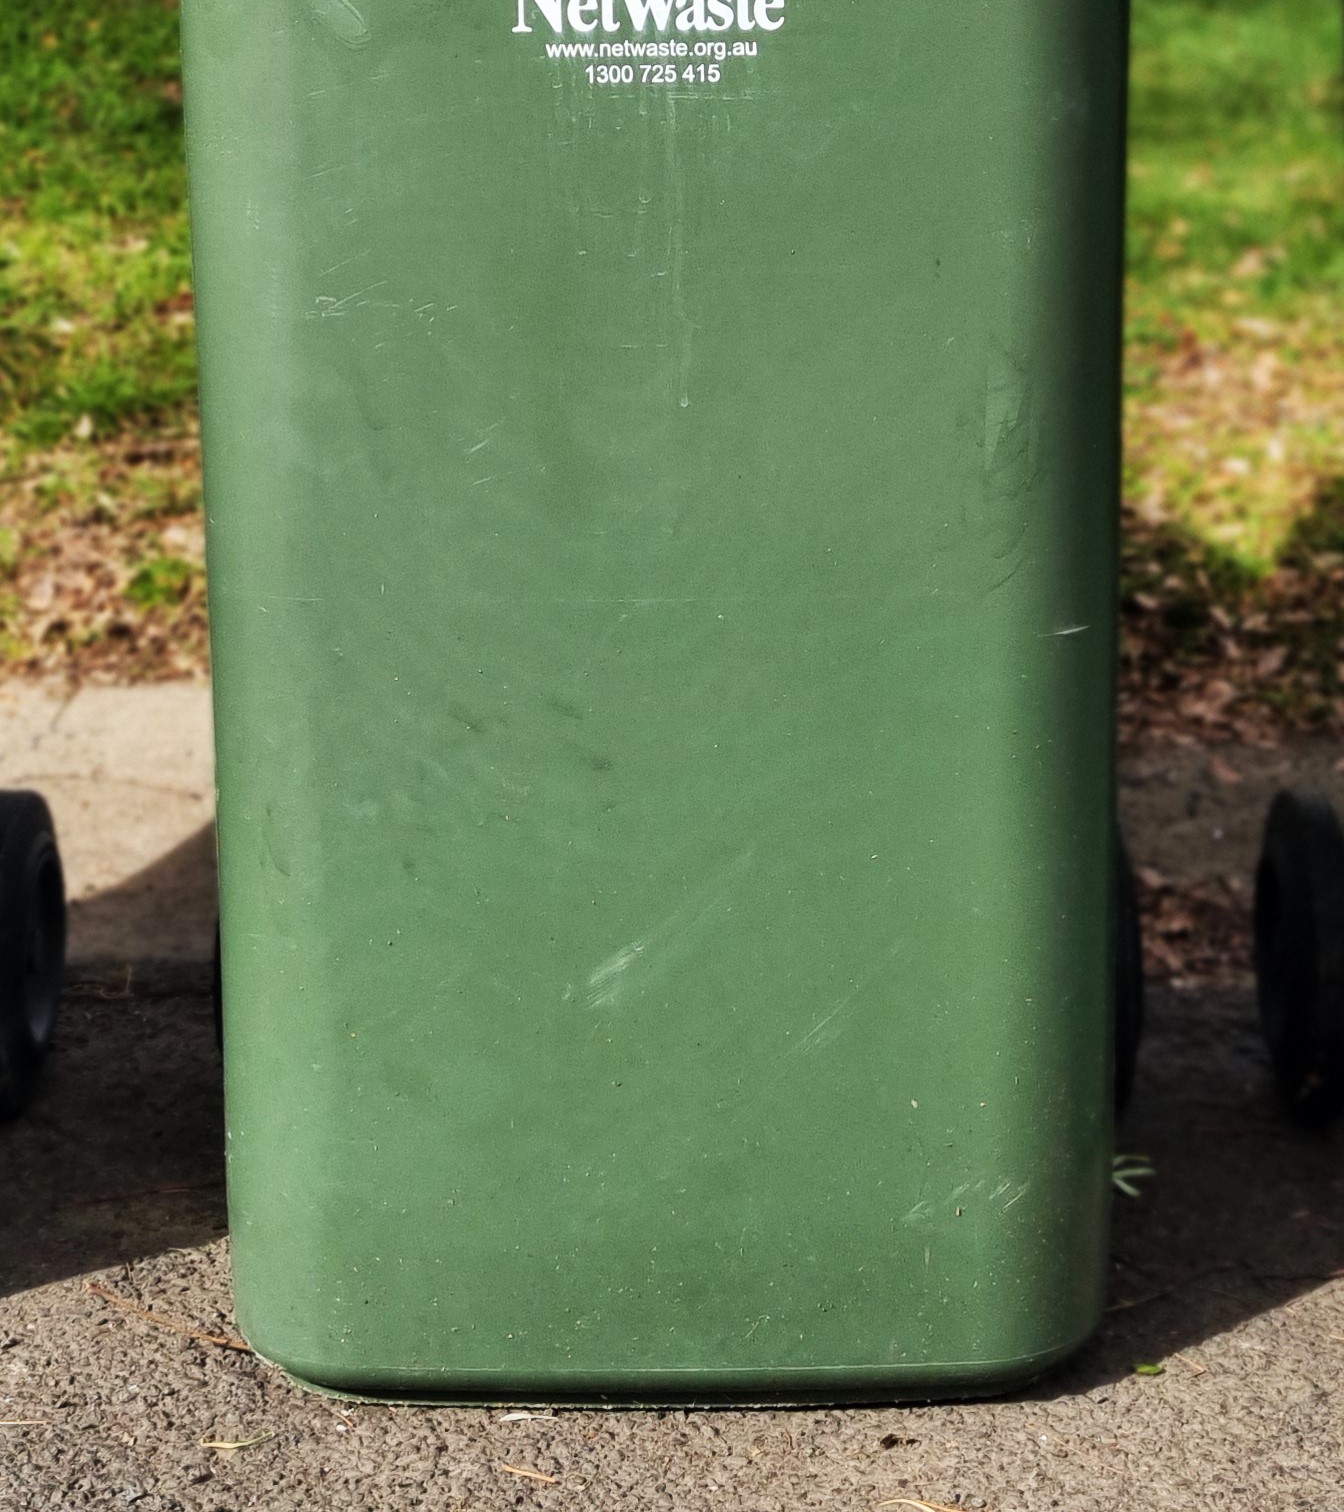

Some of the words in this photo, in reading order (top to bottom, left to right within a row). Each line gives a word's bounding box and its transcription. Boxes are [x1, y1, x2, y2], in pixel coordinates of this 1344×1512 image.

[545, 40, 758, 60] www.netwaste.org.au
[585, 65, 633, 83] 1300
[639, 64, 677, 83] 725
[682, 64, 721, 83] 415
